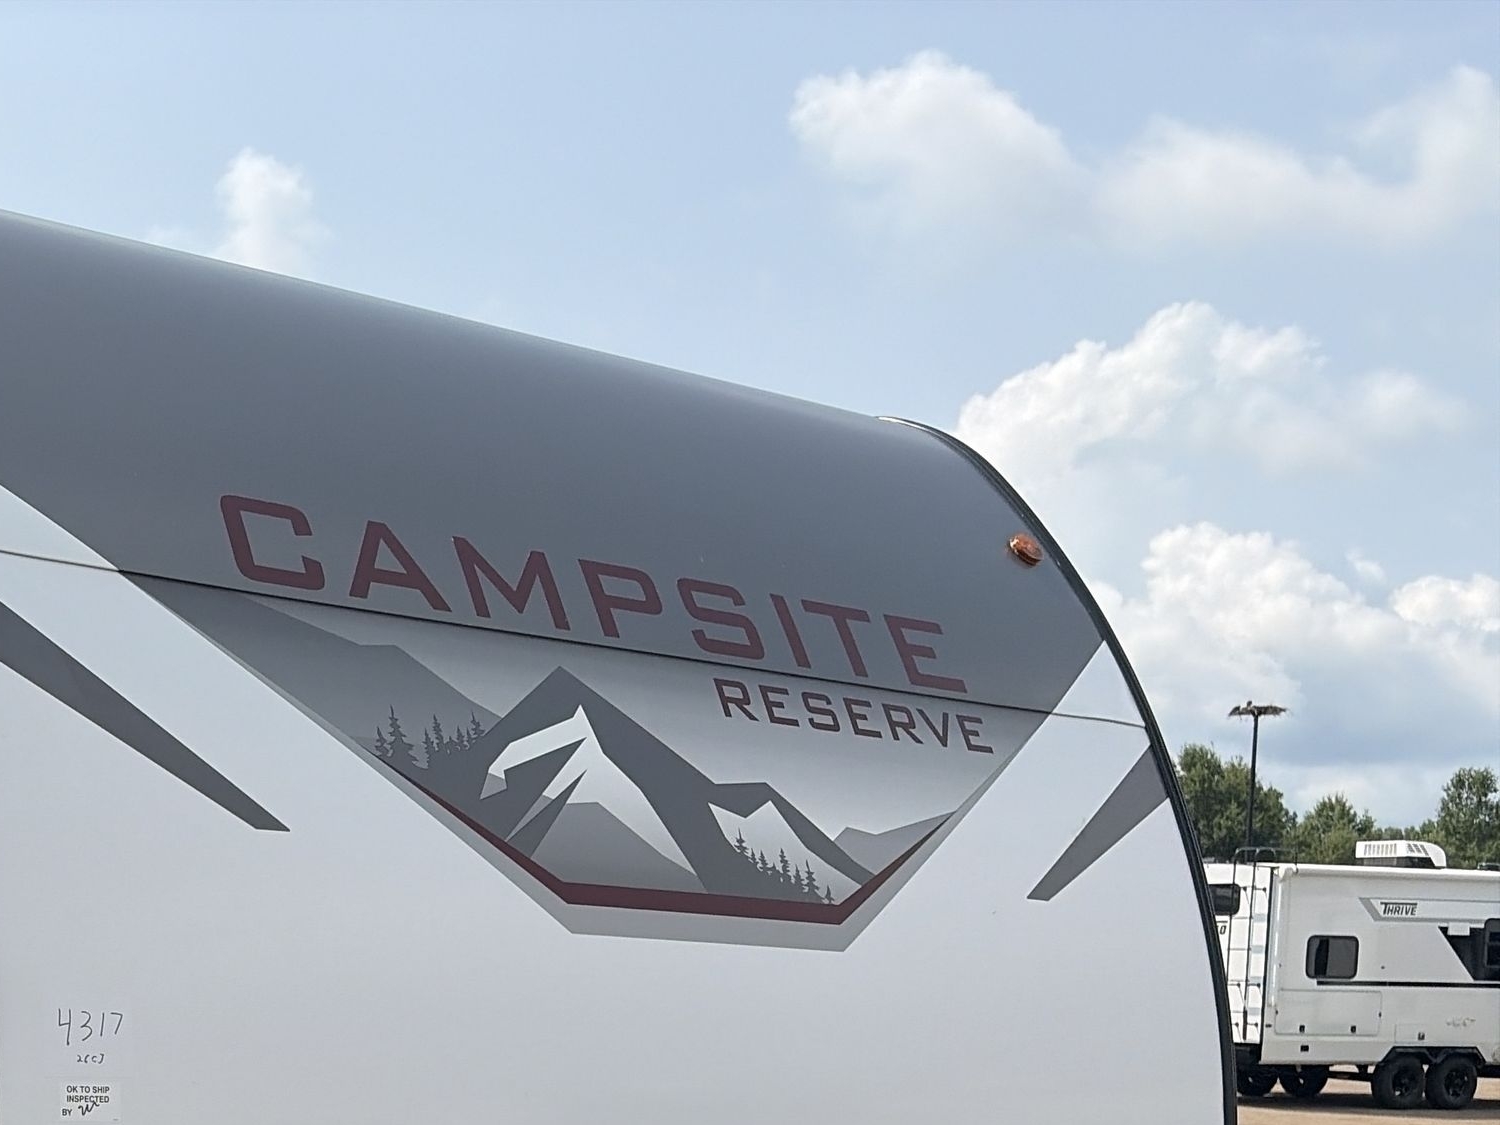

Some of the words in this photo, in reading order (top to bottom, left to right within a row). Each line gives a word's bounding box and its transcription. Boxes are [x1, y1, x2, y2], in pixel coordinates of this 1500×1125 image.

[220, 494, 967, 694] CAMPSITE
[713, 678, 994, 754] RESERVE
[1380, 901, 1418, 916] THRIVE
[58, 1008, 123, 1046] 4317
[66, 1085, 78, 1093] OK
[92, 1086, 110, 1094] SHIP
[66, 1095, 110, 1103] INSPECTED
